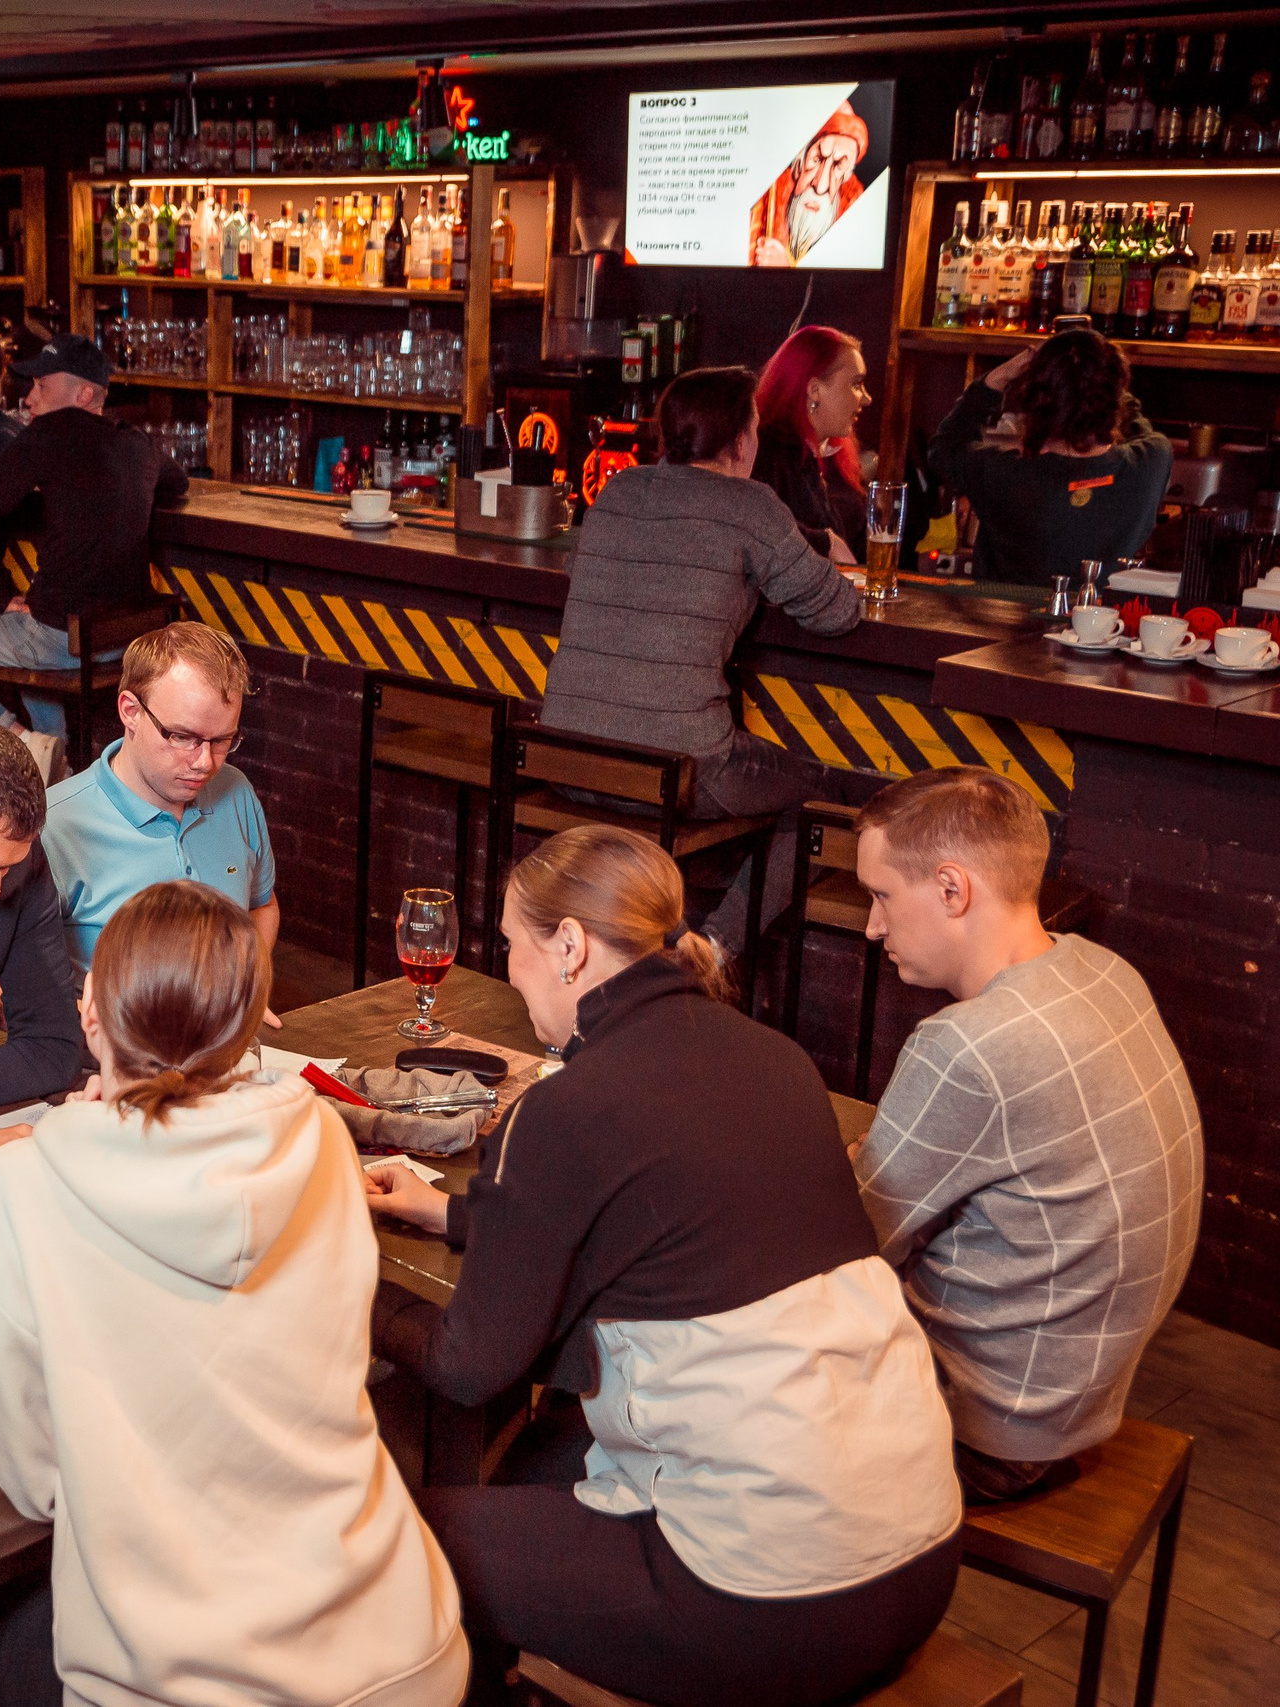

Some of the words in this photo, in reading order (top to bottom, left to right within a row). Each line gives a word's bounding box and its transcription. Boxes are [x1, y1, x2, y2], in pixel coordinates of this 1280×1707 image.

[640, 98, 687, 108] ВОПРОС
[465, 130, 510, 160] ken
[636, 241, 680, 250] Назовите
